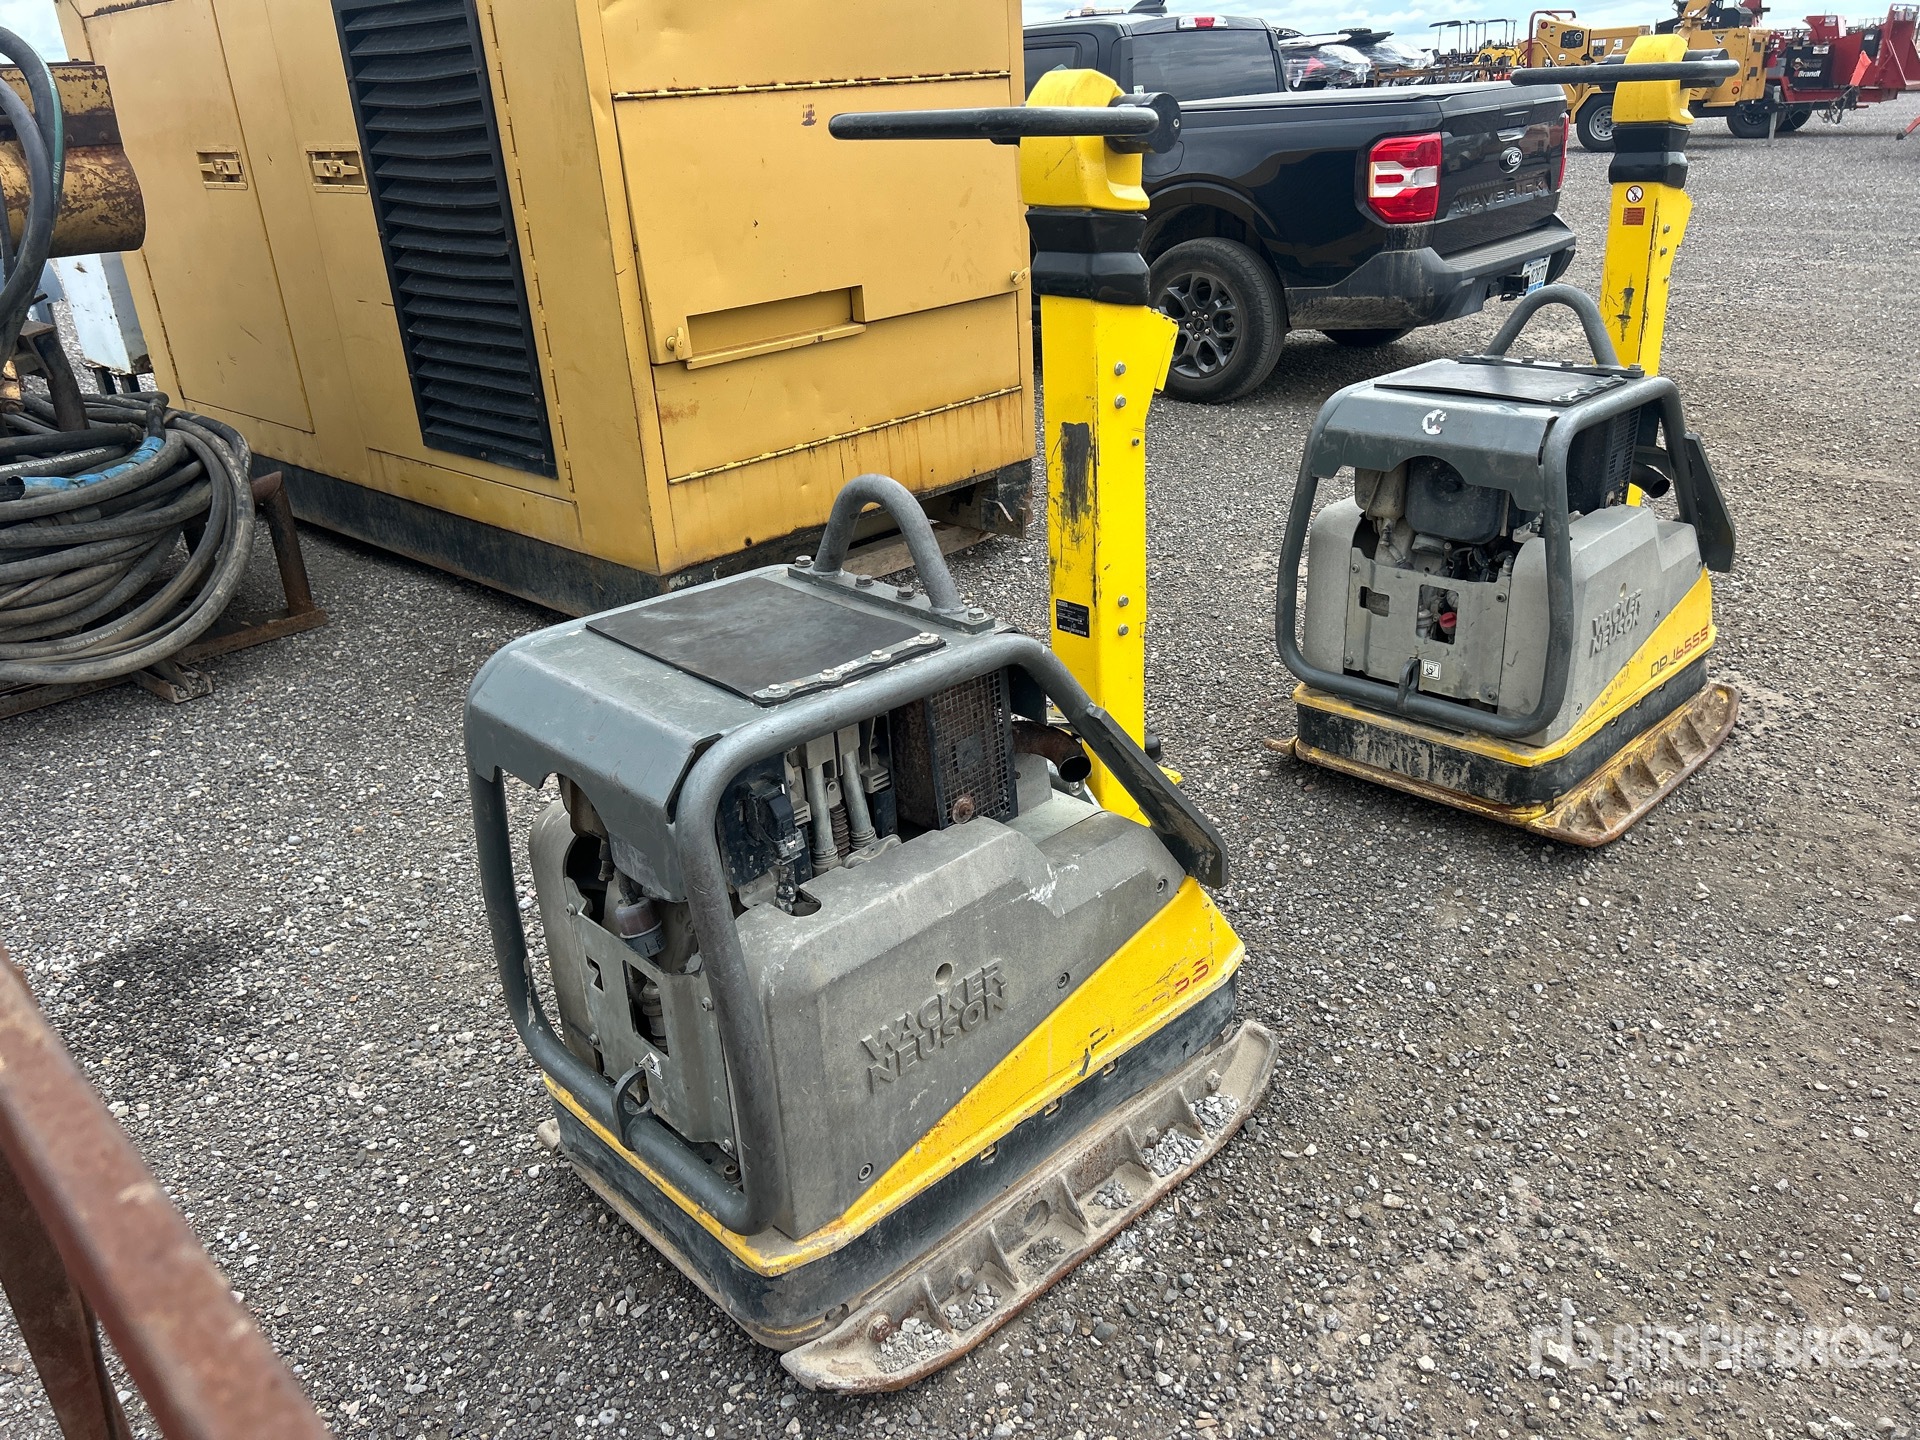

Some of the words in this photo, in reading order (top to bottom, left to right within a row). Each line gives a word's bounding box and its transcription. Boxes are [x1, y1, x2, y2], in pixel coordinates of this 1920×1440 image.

[1798, 70, 1821, 78] Brandt
[1453, 180, 1546, 212] MAVERICK
[1589, 599, 1640, 659] NEUSON
[1592, 588, 1642, 637] WACKER
[86, 636, 98, 645] SAE
[860, 957, 1008, 1061] WACKER
[867, 992, 1008, 1095] NEUSON
